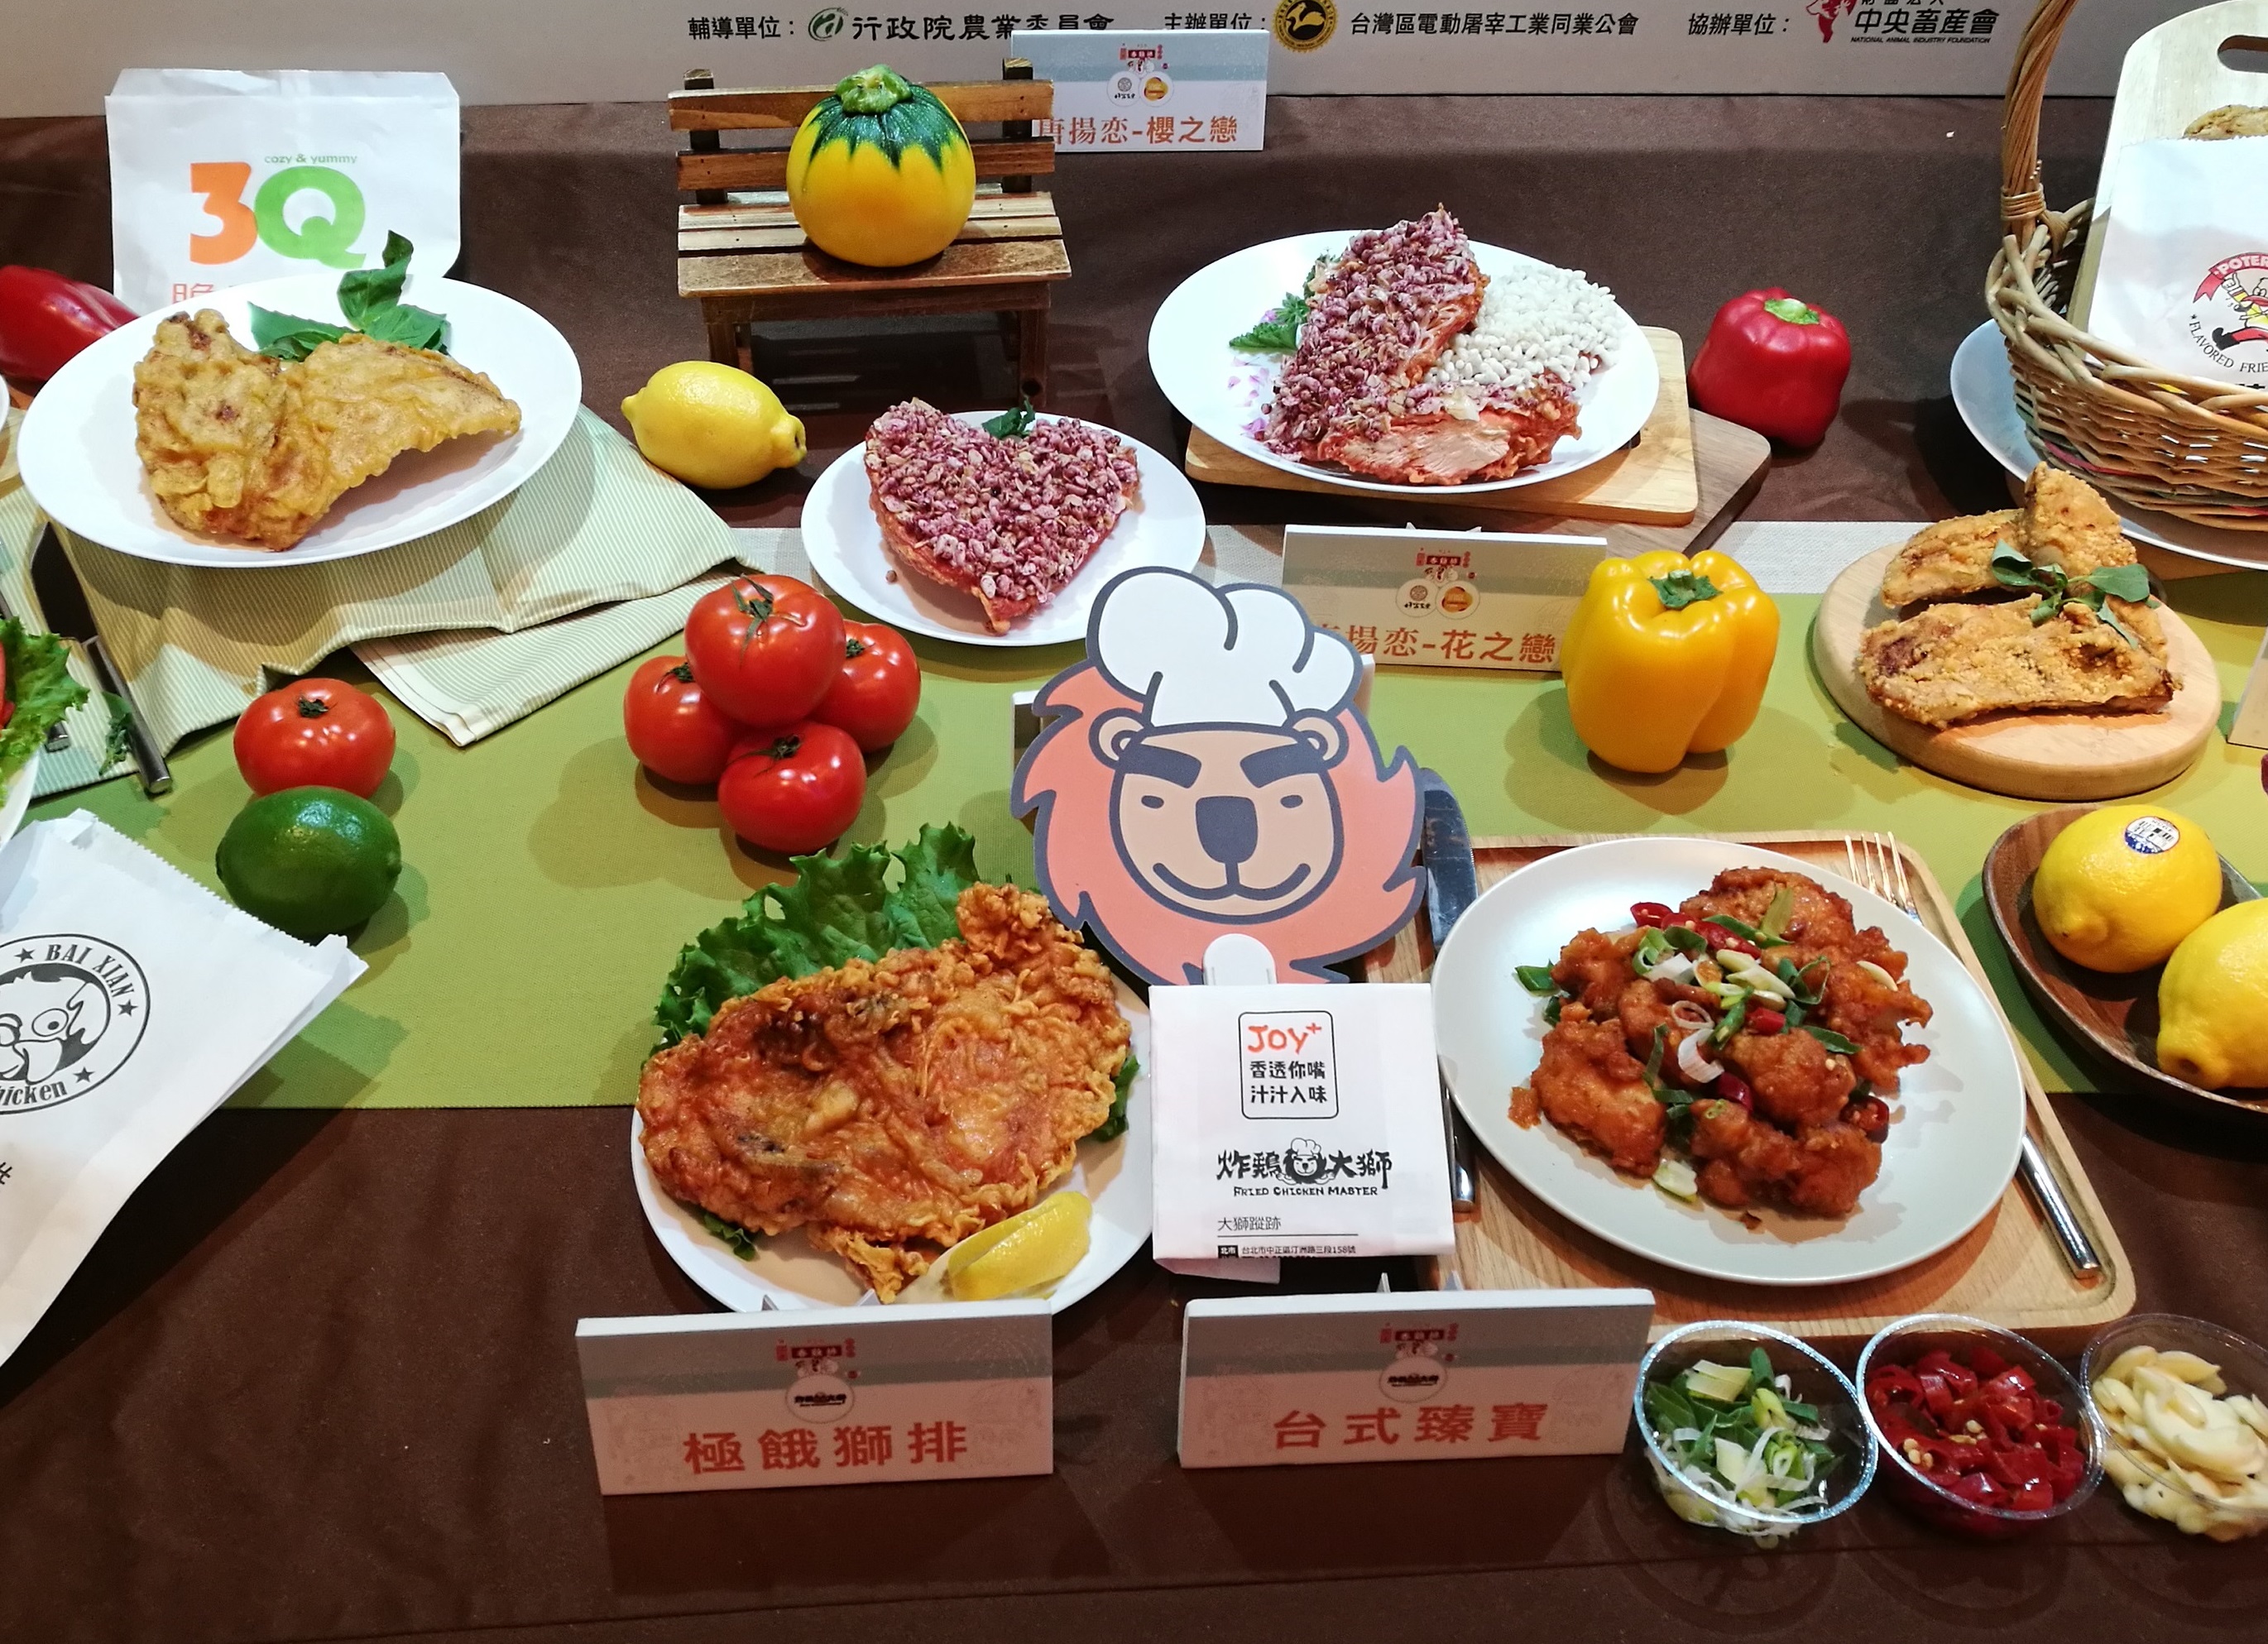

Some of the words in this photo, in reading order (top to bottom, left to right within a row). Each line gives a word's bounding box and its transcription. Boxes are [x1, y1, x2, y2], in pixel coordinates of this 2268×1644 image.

[1350, 12, 1639, 36] 台灣區電動屠宰工業同業公會
[1854, 8, 2000, 34] 中央畜產會
[264, 155, 292, 164] cozy
[296, 153, 306, 163] &
[310, 155, 357, 165] yummy
[189, 161, 367, 269] 3Q
[2189, 320, 2234, 368] FLAVORED
[45, 944, 93, 965] BAI
[93, 955, 135, 998] XIAN
[1249, 1060, 1326, 1080] 香透你嘴
[1250, 1084, 1327, 1104] 汁汁入味
[1234, 1186, 1269, 1196] FRIED
[1273, 1186, 1324, 1196] CHICKEN
[1328, 1186, 1378, 1196] MASTER
[1273, 1402, 1548, 1449] 台式臻寶
[683, 1421, 967, 1474] 極餓獅排
